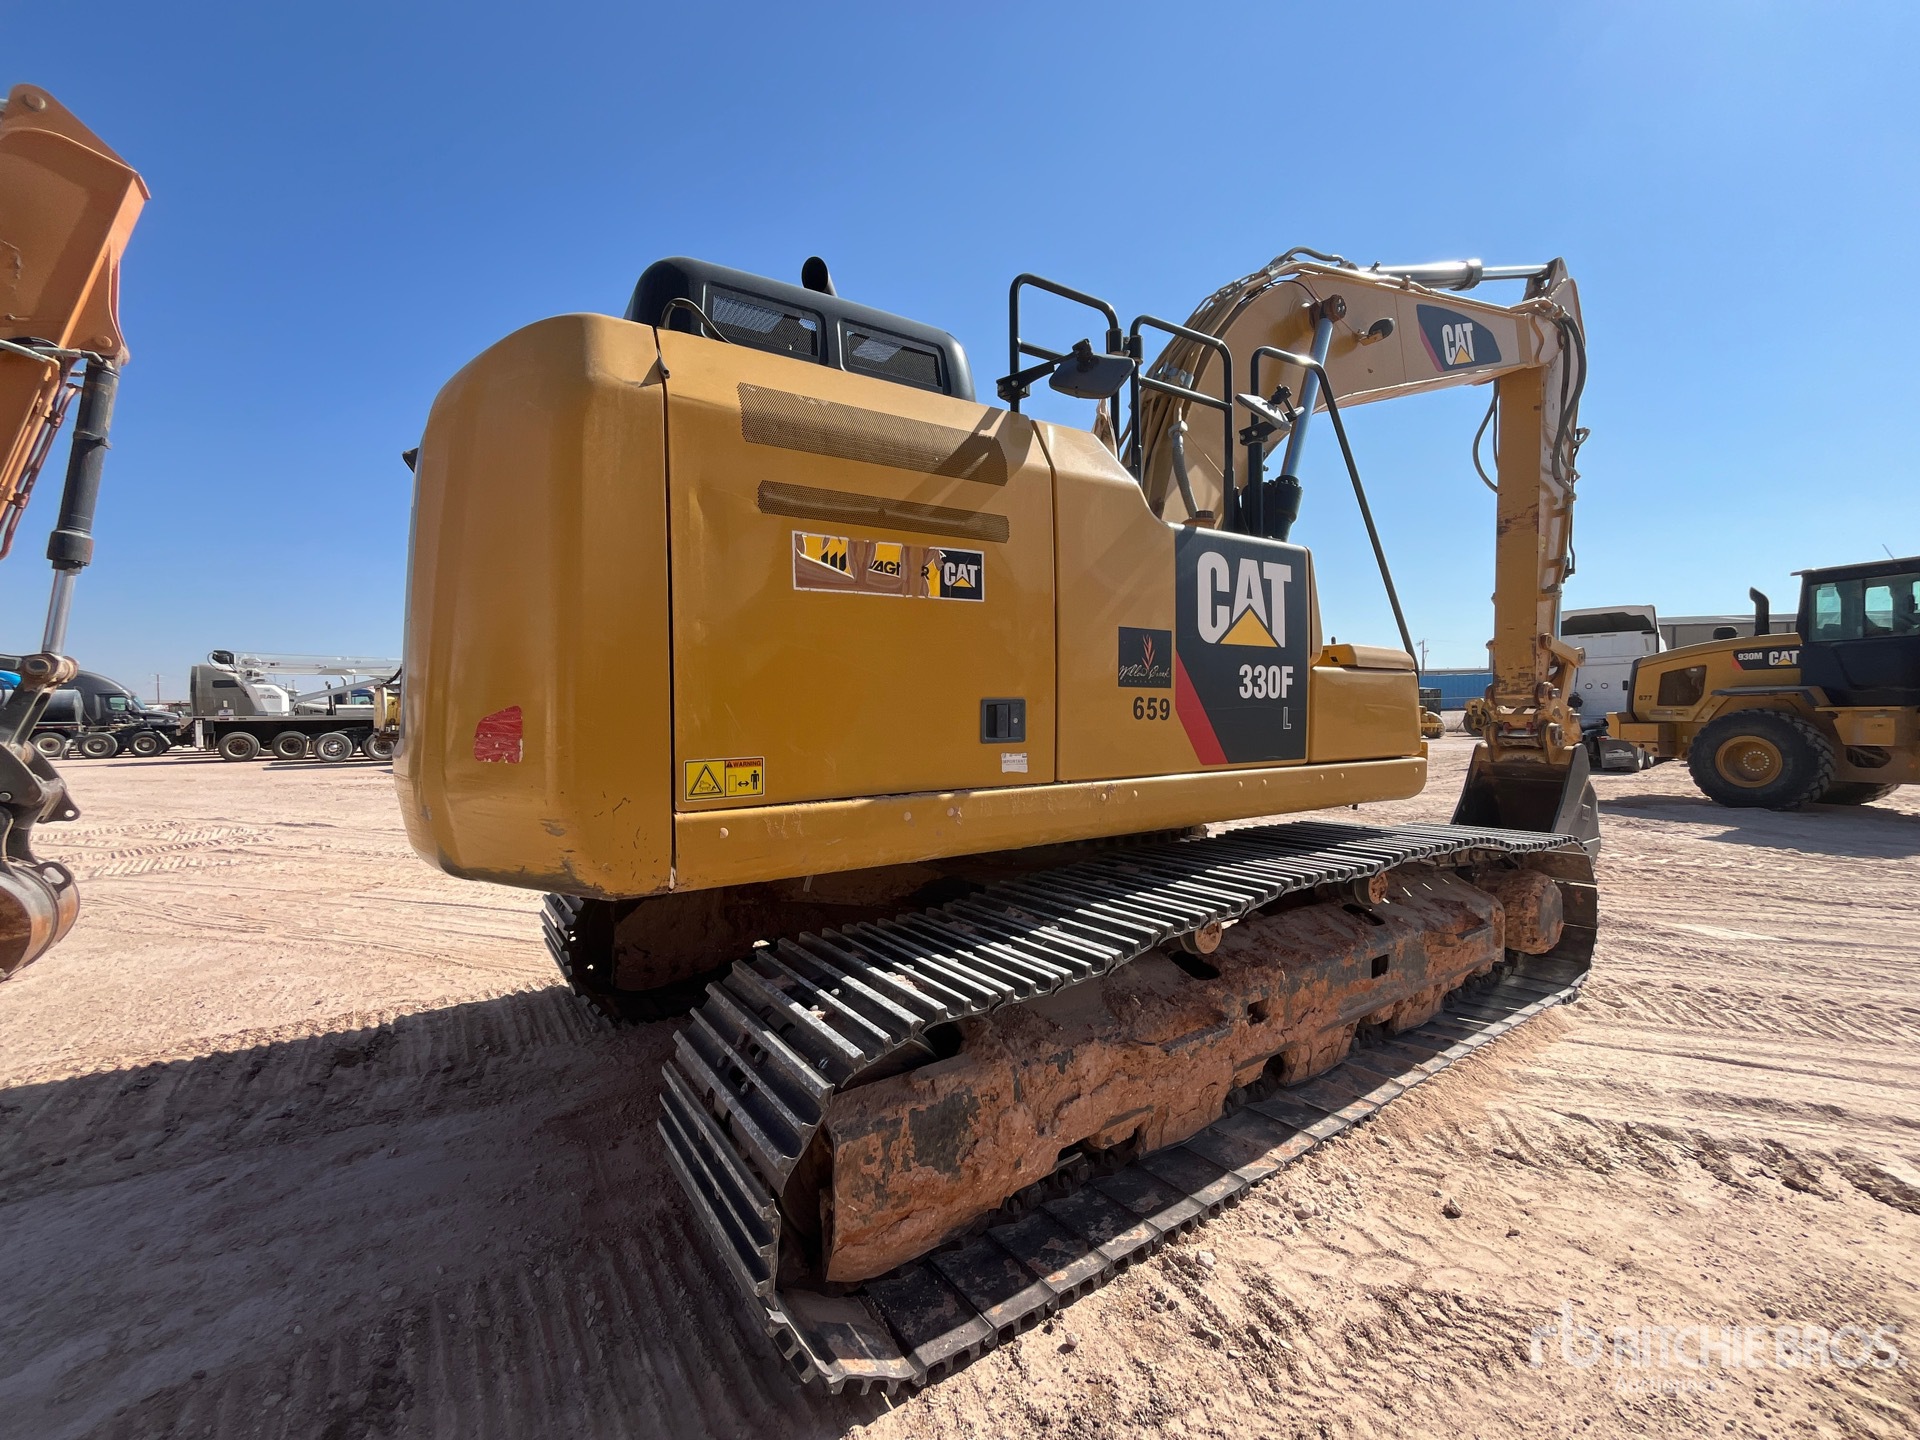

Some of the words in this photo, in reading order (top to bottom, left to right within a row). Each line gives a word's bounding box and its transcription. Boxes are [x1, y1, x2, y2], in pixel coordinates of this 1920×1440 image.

[1442, 322, 1475, 366] CAT
[943, 562, 978, 588] CAT
[1197, 551, 1292, 648] CAT
[1738, 652, 1763, 661] 930M
[1768, 650, 1800, 666] CAT
[1239, 664, 1294, 699] 330F
[1132, 696, 1171, 721] 659
[1282, 706, 1292, 729] L
